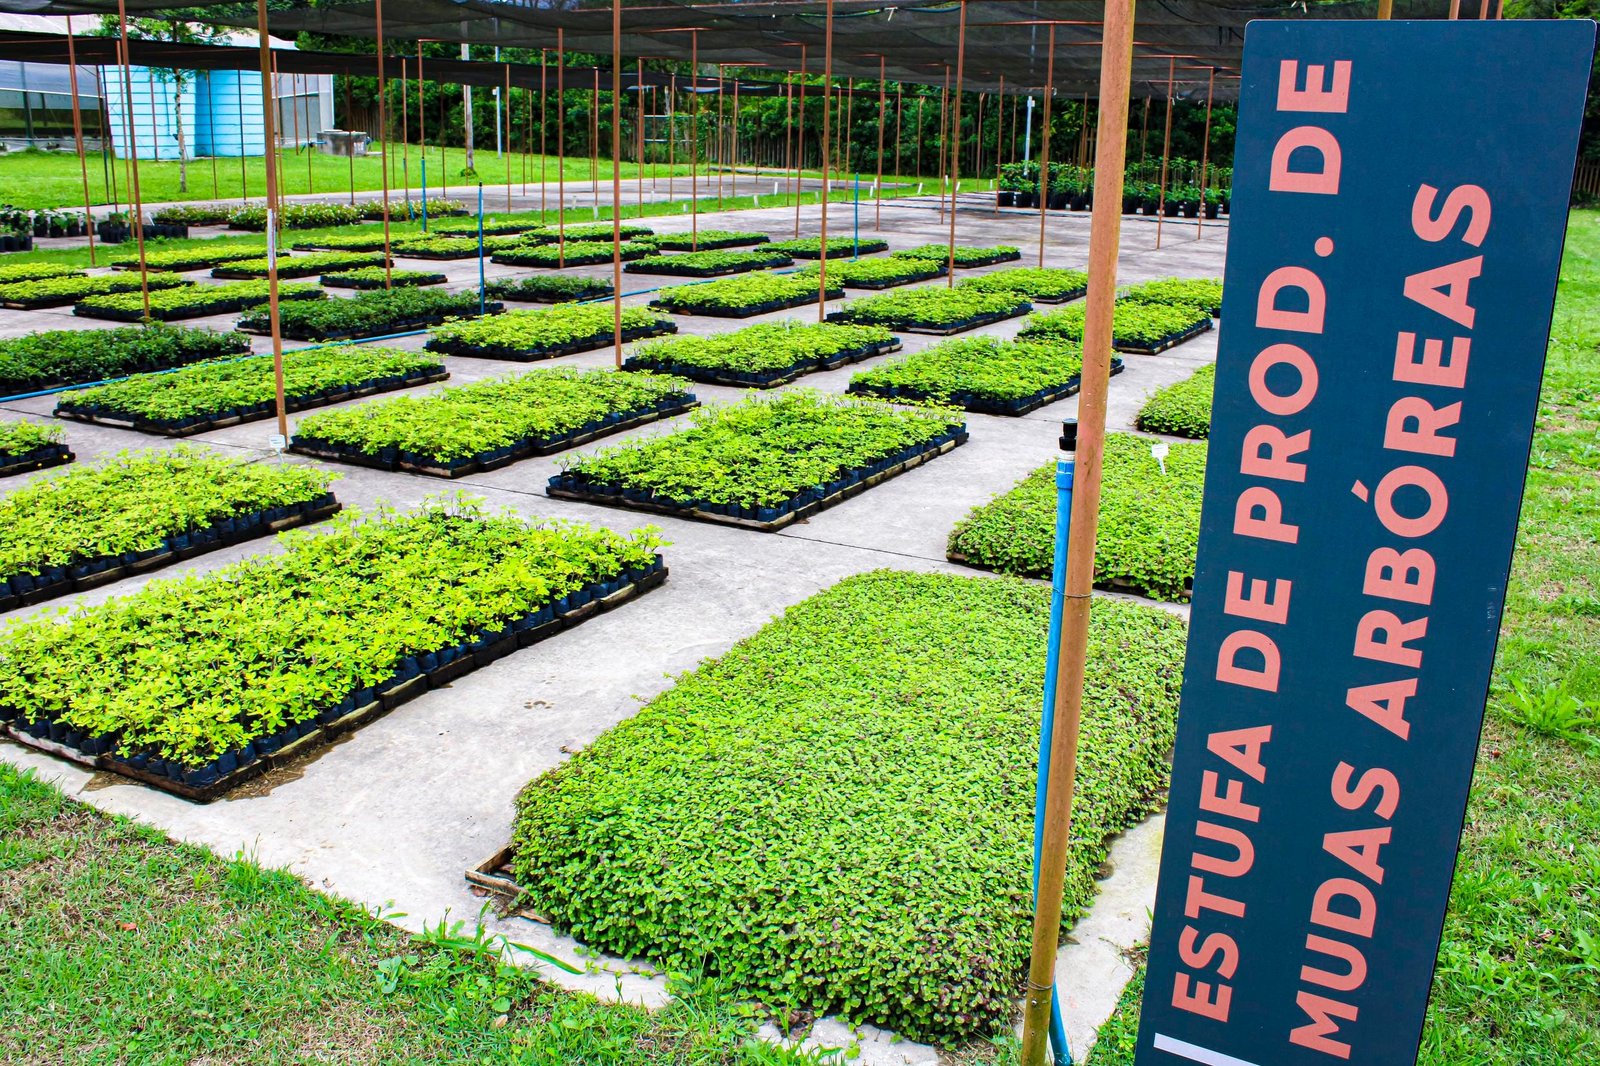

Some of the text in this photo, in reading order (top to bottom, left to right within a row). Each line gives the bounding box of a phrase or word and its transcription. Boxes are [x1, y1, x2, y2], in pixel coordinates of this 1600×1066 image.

[1172, 60, 1351, 1022] ESTUFA DE PROD. DE
[1290, 184, 1491, 1058] MUDAS ARBÓREAS
